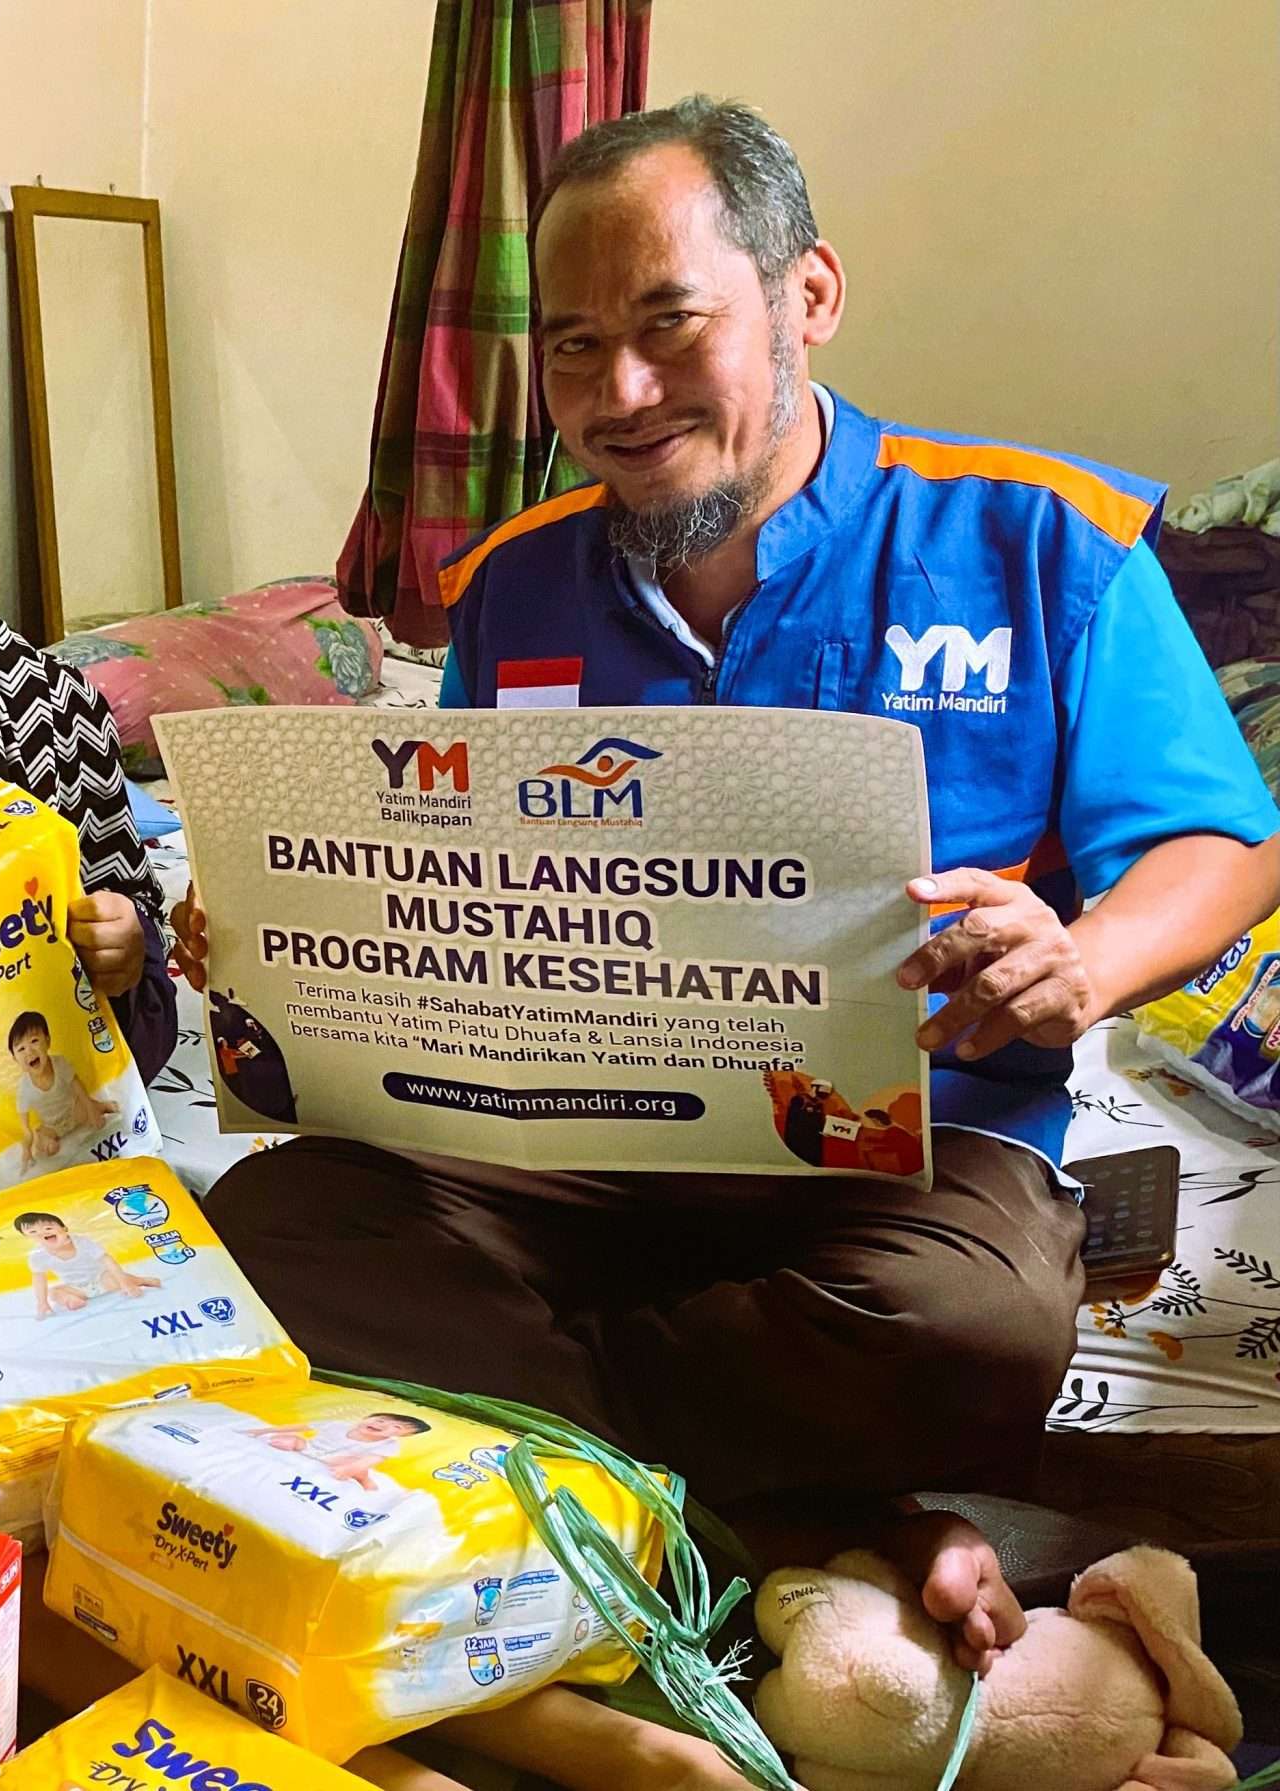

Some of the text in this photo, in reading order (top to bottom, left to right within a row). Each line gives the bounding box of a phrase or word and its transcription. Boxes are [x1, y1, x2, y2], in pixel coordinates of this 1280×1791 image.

[885, 624, 1012, 694] YM
[882, 693, 1007, 714] Yatim Mandiri
[372, 738, 470, 793] YM
[376, 791, 471, 809] Yatim Mandiri
[381, 808, 471, 828] Balikpapan
[518, 778, 643, 818] BLM
[268, 835, 807, 899] BANTUAN LANGSUNG
[387, 893, 655, 951] MUSTAHIQ
[262, 928, 821, 1006] PROGRAM KESEHATAN
[295, 981, 785, 1034] Terima kasih #SahabatYatimMandiri yang telah
[287, 1003, 804, 1053] membantu Yatim Piatu Dhuafa & Lansia Indonesia
[291, 1022, 370, 1044] bersama
[375, 1032, 408, 1049] kita
[470, 1045, 586, 1065] Mandirikan
[593, 1050, 657, 1067] Yatim
[664, 1053, 705, 1069] dan
[407, 1080, 676, 1117] www.yatimmandiri.org
[90, 1131, 129, 1163] XXL
[141, 1310, 203, 1339] XXL
[206, 1300, 229, 1315] 24
[280, 1475, 340, 1512] XXL
[153, 1533, 210, 1573] Dry X-Pert
[156, 1501, 238, 1569] Sweety
[0, 1561, 18, 1592] SUN
[466, 1637, 478, 1651] 12
[478, 1637, 498, 1649] JAM
[176, 1644, 239, 1711] XXL
[255, 1687, 279, 1716] 24
[112, 1718, 272, 1791] Swe
